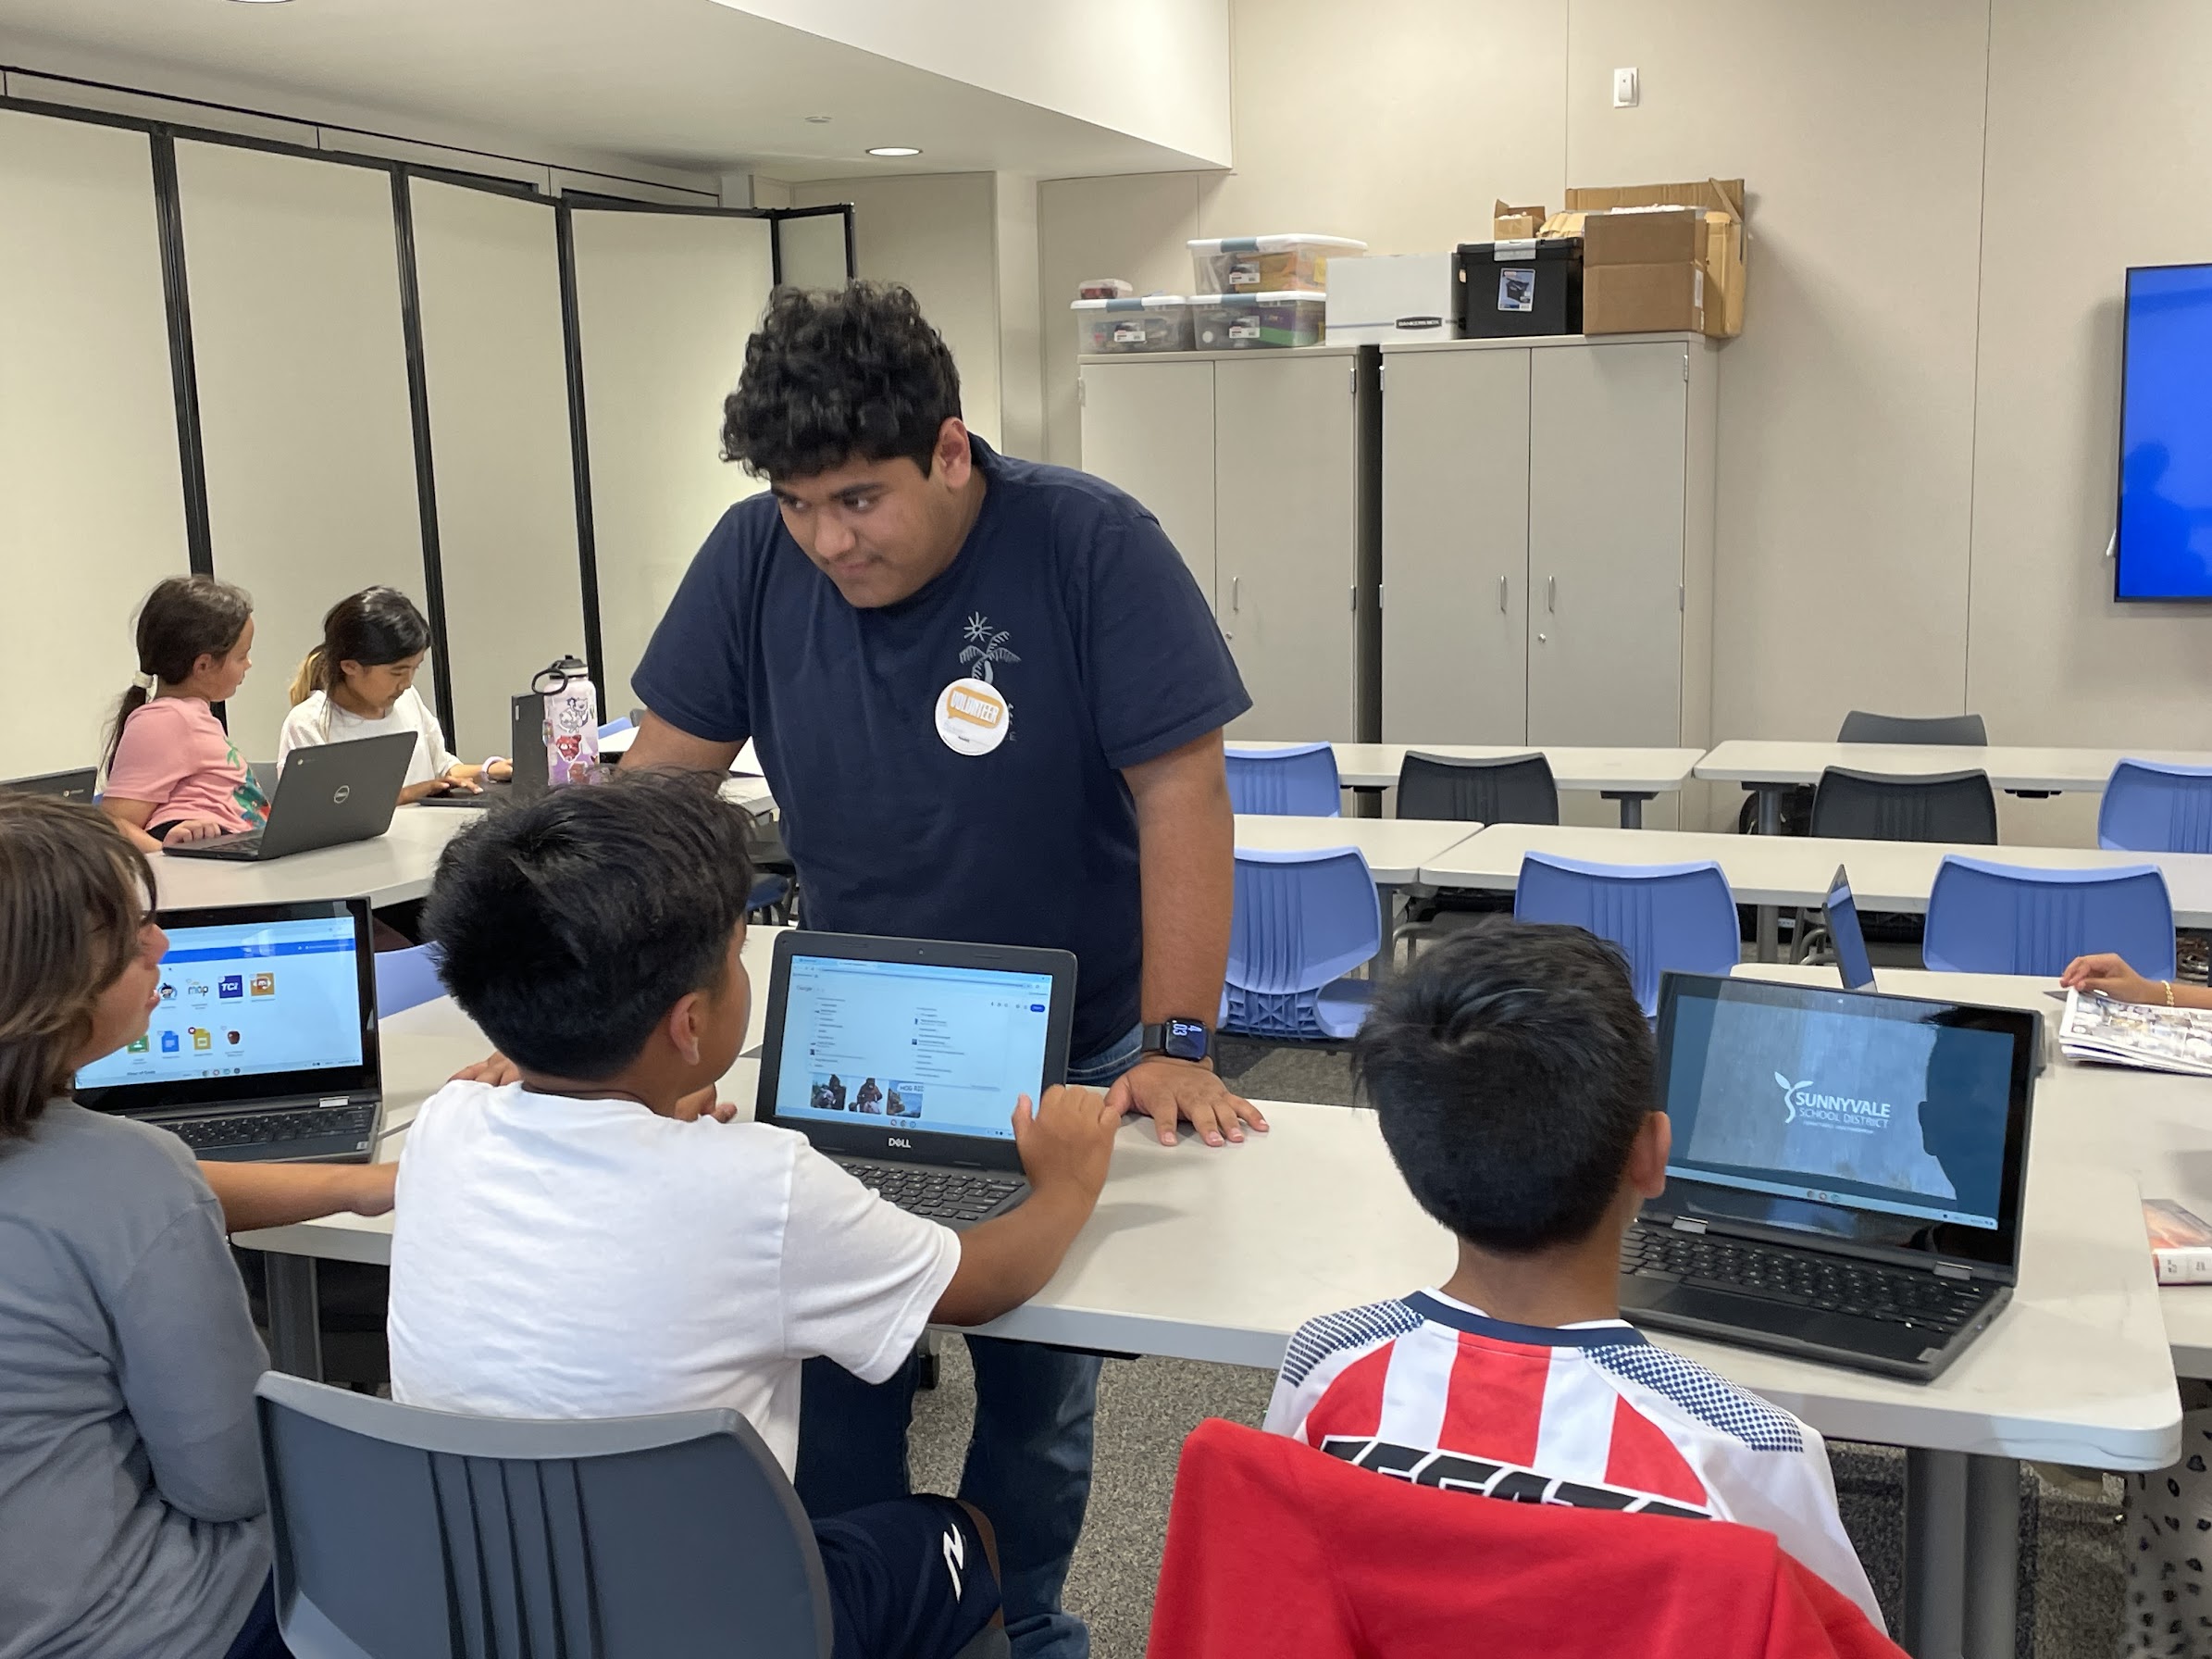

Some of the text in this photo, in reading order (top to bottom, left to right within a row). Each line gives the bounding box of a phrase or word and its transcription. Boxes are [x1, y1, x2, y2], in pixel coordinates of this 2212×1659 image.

[1796, 1091, 1891, 1118] SUNNYVALE
[1799, 1107, 1841, 1122] SCHOOL
[1843, 1113, 1889, 1129] DISTRICT
[888, 1137, 912, 1149] DELL
